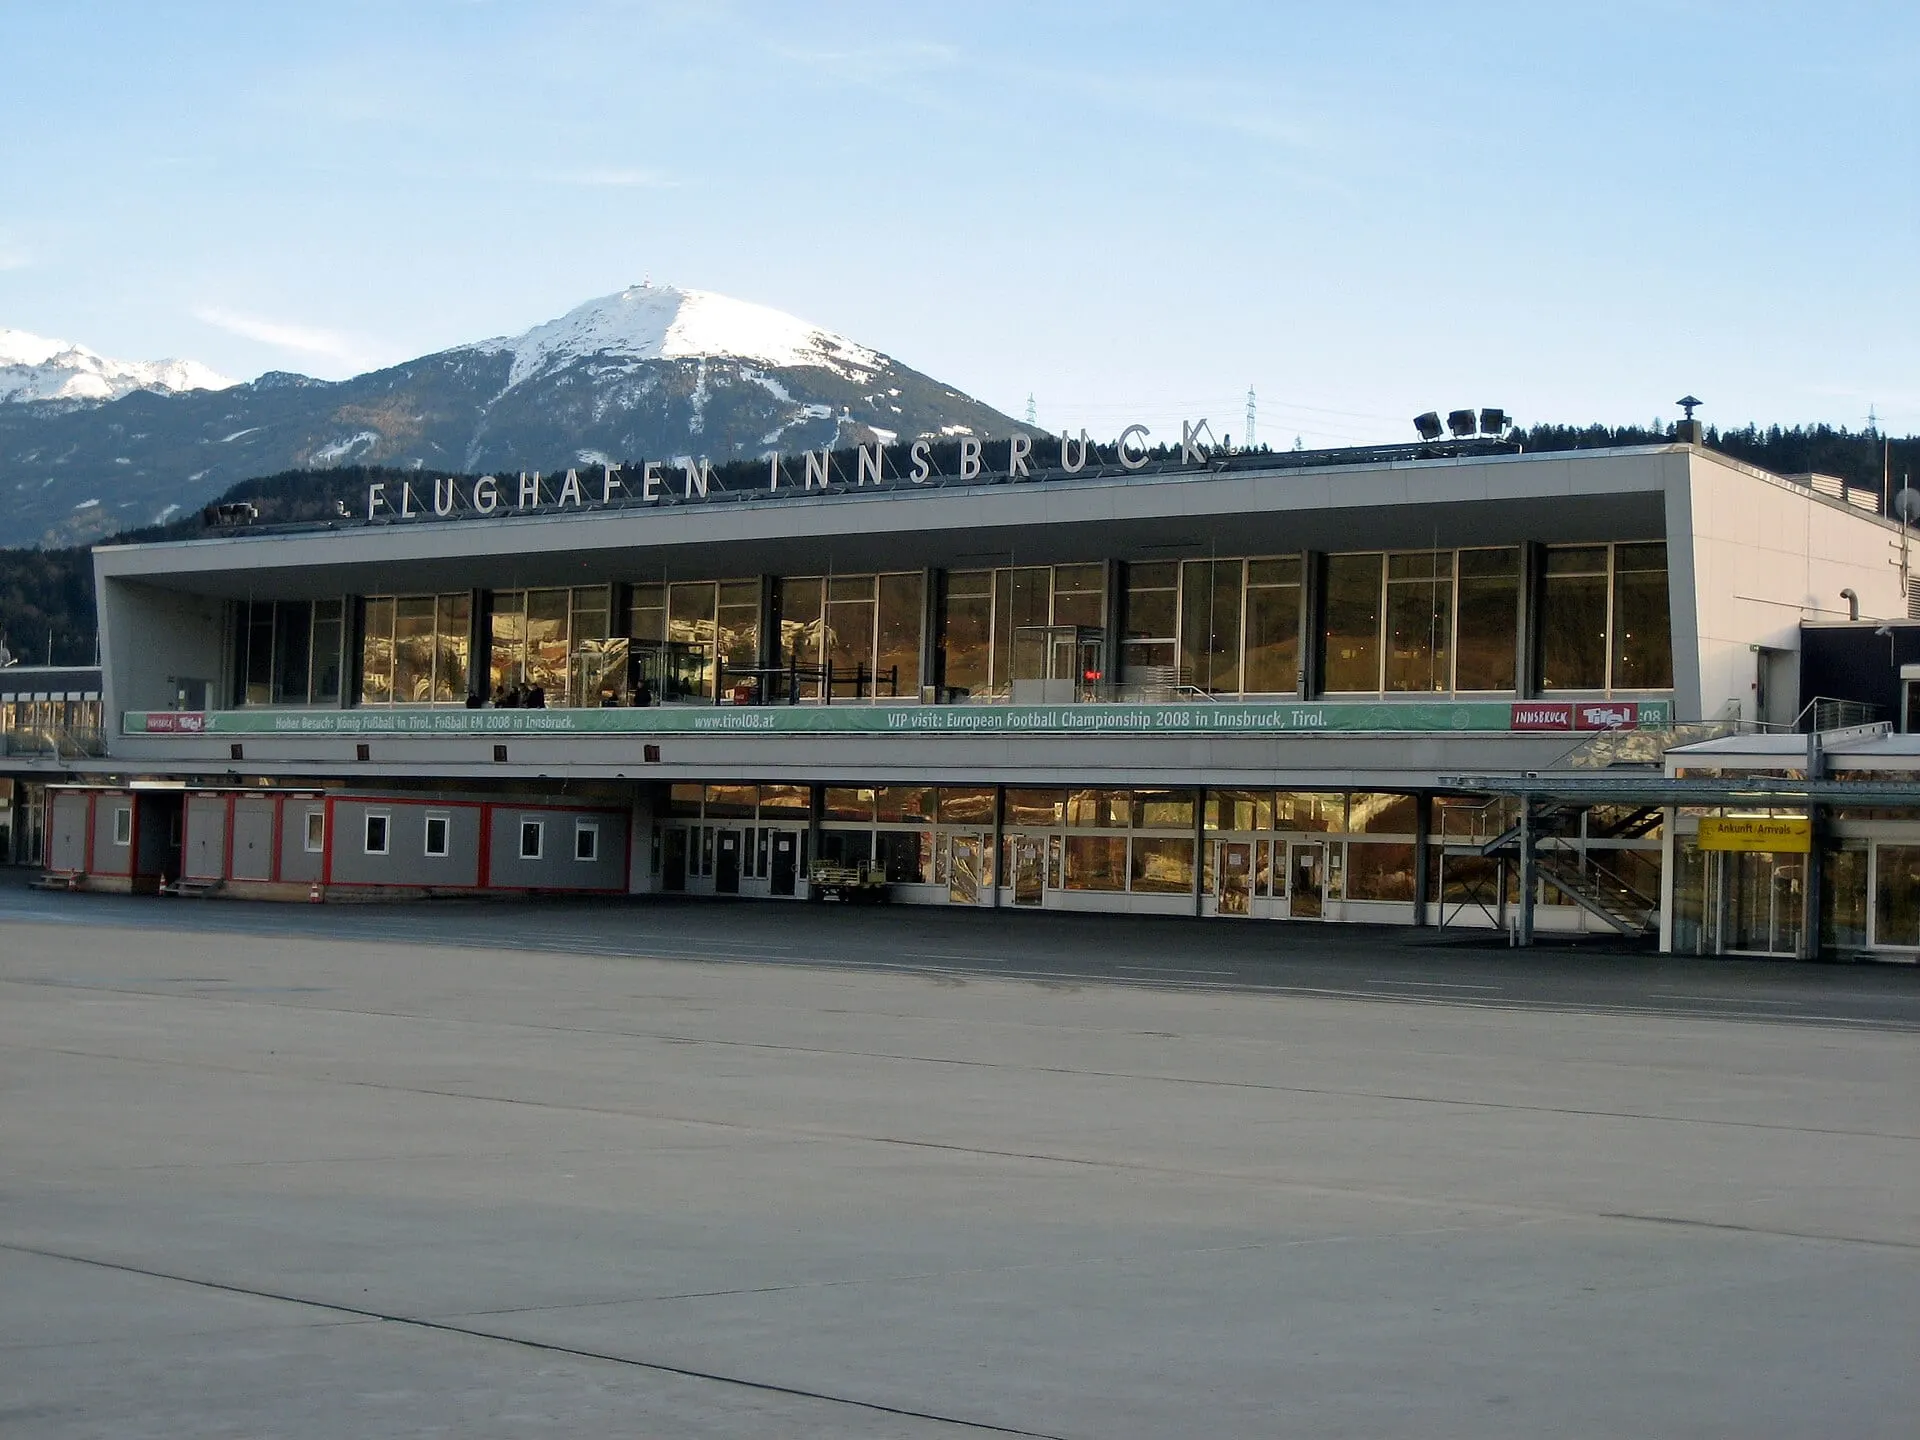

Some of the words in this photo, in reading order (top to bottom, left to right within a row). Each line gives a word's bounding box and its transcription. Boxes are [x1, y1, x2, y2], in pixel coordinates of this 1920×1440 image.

[368, 456, 710, 520] FLUGHAFEN
[770, 418, 1208, 493] INNSBRUCK
[397, 715, 406, 729] in
[409, 715, 431, 729] Tirol.
[435, 715, 467, 729] Fußball
[471, 715, 484, 729] EM
[487, 715, 510, 728] 2008
[513, 714, 522, 728] in
[526, 714, 575, 729] Innsbruck.
[694, 714, 775, 728] www.tirol08.at
[888, 713, 908, 727] VIP
[911, 713, 942, 727] visit:
[947, 713, 1002, 730] European
[1006, 712, 1057, 727] Football
[1062, 711, 1150, 729] Championship
[1156, 711, 1190, 727] 2008
[1195, 711, 1208, 726] in
[1213, 711, 1286, 728] Innsbruck,
[1291, 711, 1328, 726] Tirol.
[1515, 711, 1568, 724] INNSBRUCK
[1583, 707, 1633, 727] Tirol
[1717, 823, 1753, 834] Ankunft
[1758, 823, 1791, 835] Arrivals
